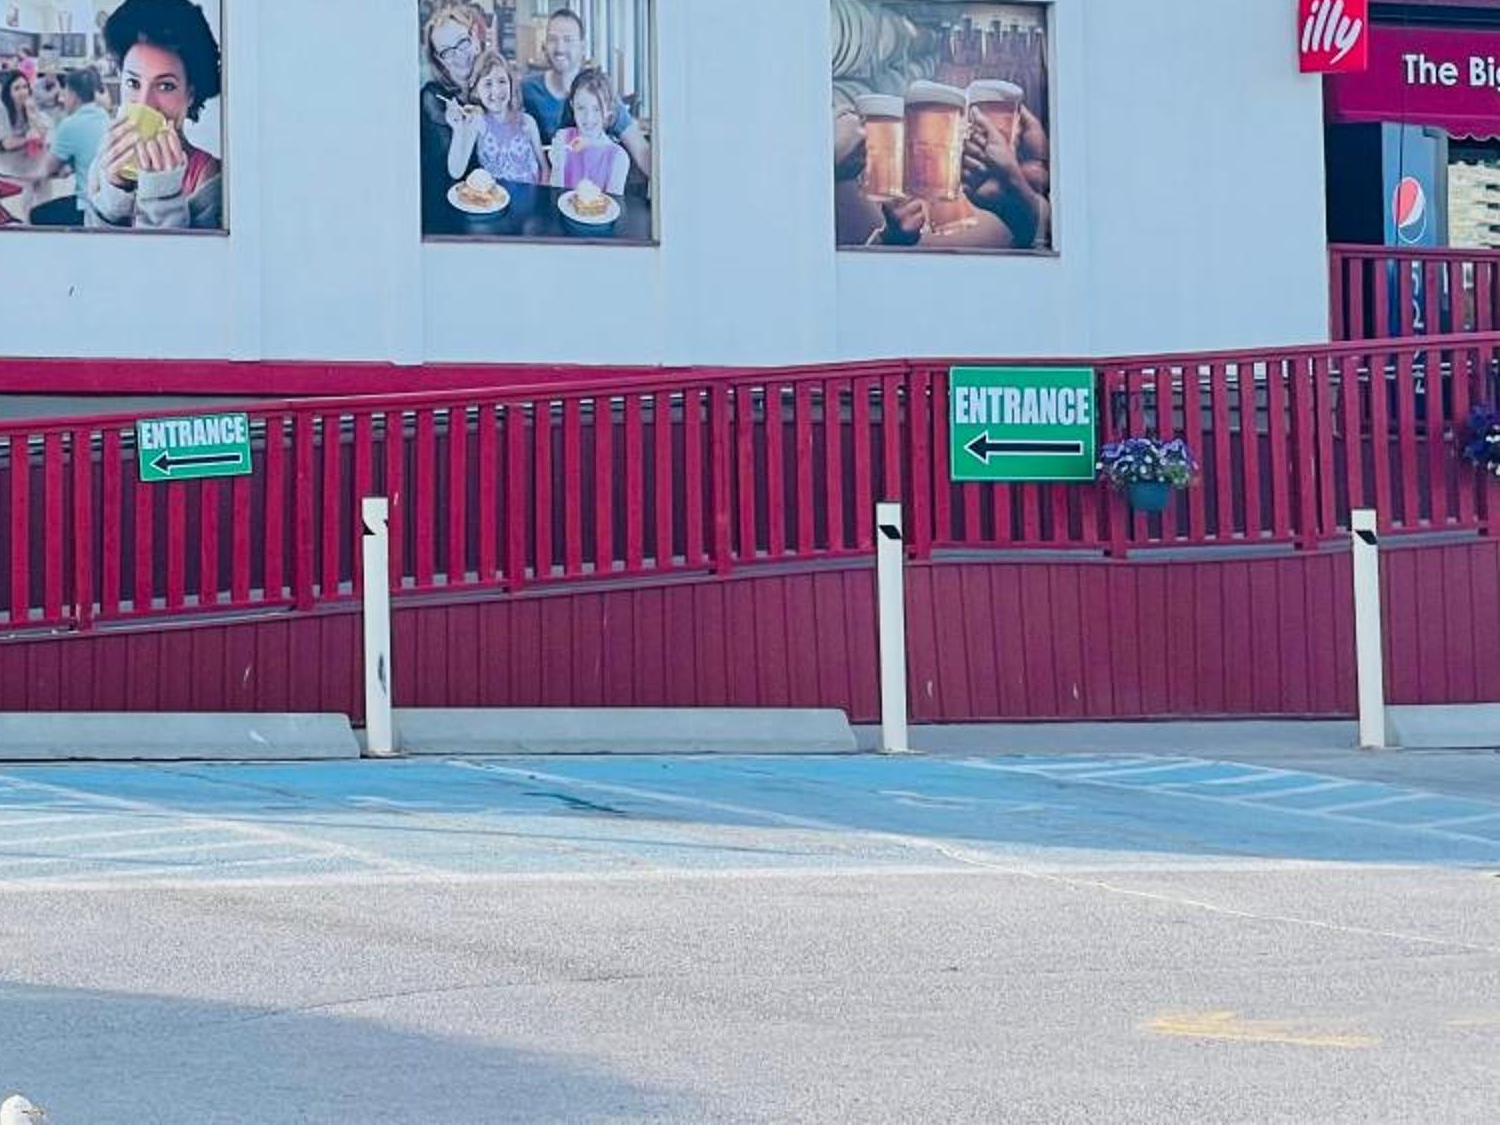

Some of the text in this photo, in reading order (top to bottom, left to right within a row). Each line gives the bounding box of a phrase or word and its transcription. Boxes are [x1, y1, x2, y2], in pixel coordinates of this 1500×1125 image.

[1402, 53, 1459, 86] The
[955, 386, 1090, 425] ENTRANCE
[141, 416, 245, 450] ENTRANCE
